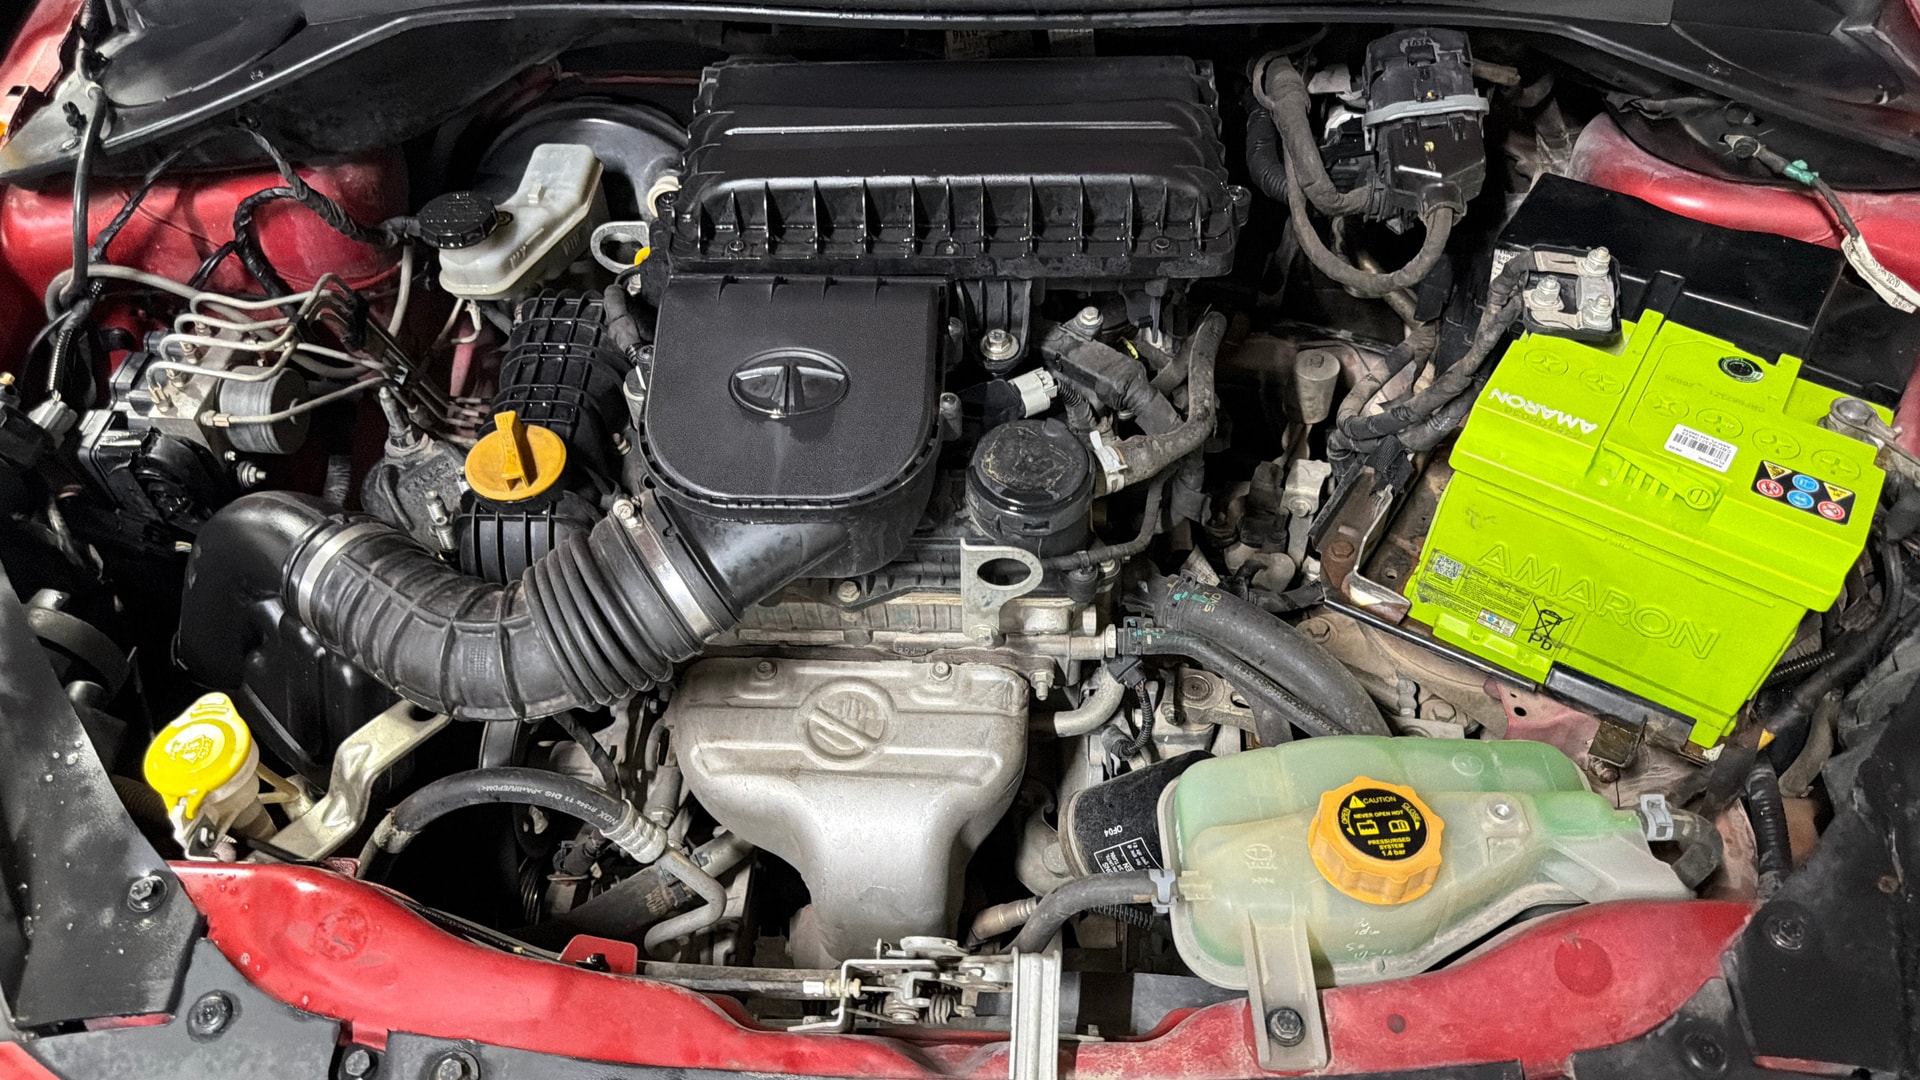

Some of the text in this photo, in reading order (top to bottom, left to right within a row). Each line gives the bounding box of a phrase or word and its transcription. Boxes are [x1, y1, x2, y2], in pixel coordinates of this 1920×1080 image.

[1488, 388, 1598, 434] AMARON
[1477, 545, 1720, 660] AMARON
[1527, 632, 1553, 651] Pb
[544, 790, 563, 800] DIS
[1362, 796, 1397, 805] CAUTION
[1341, 806, 1351, 825] OPEN
[1401, 802, 1422, 823] CLOSE
[1104, 825, 1123, 838] OF04
[1367, 837, 1411, 846] PRESSURISED
[1379, 843, 1405, 851] SYSTEM
[1393, 849, 1406, 857] bar
